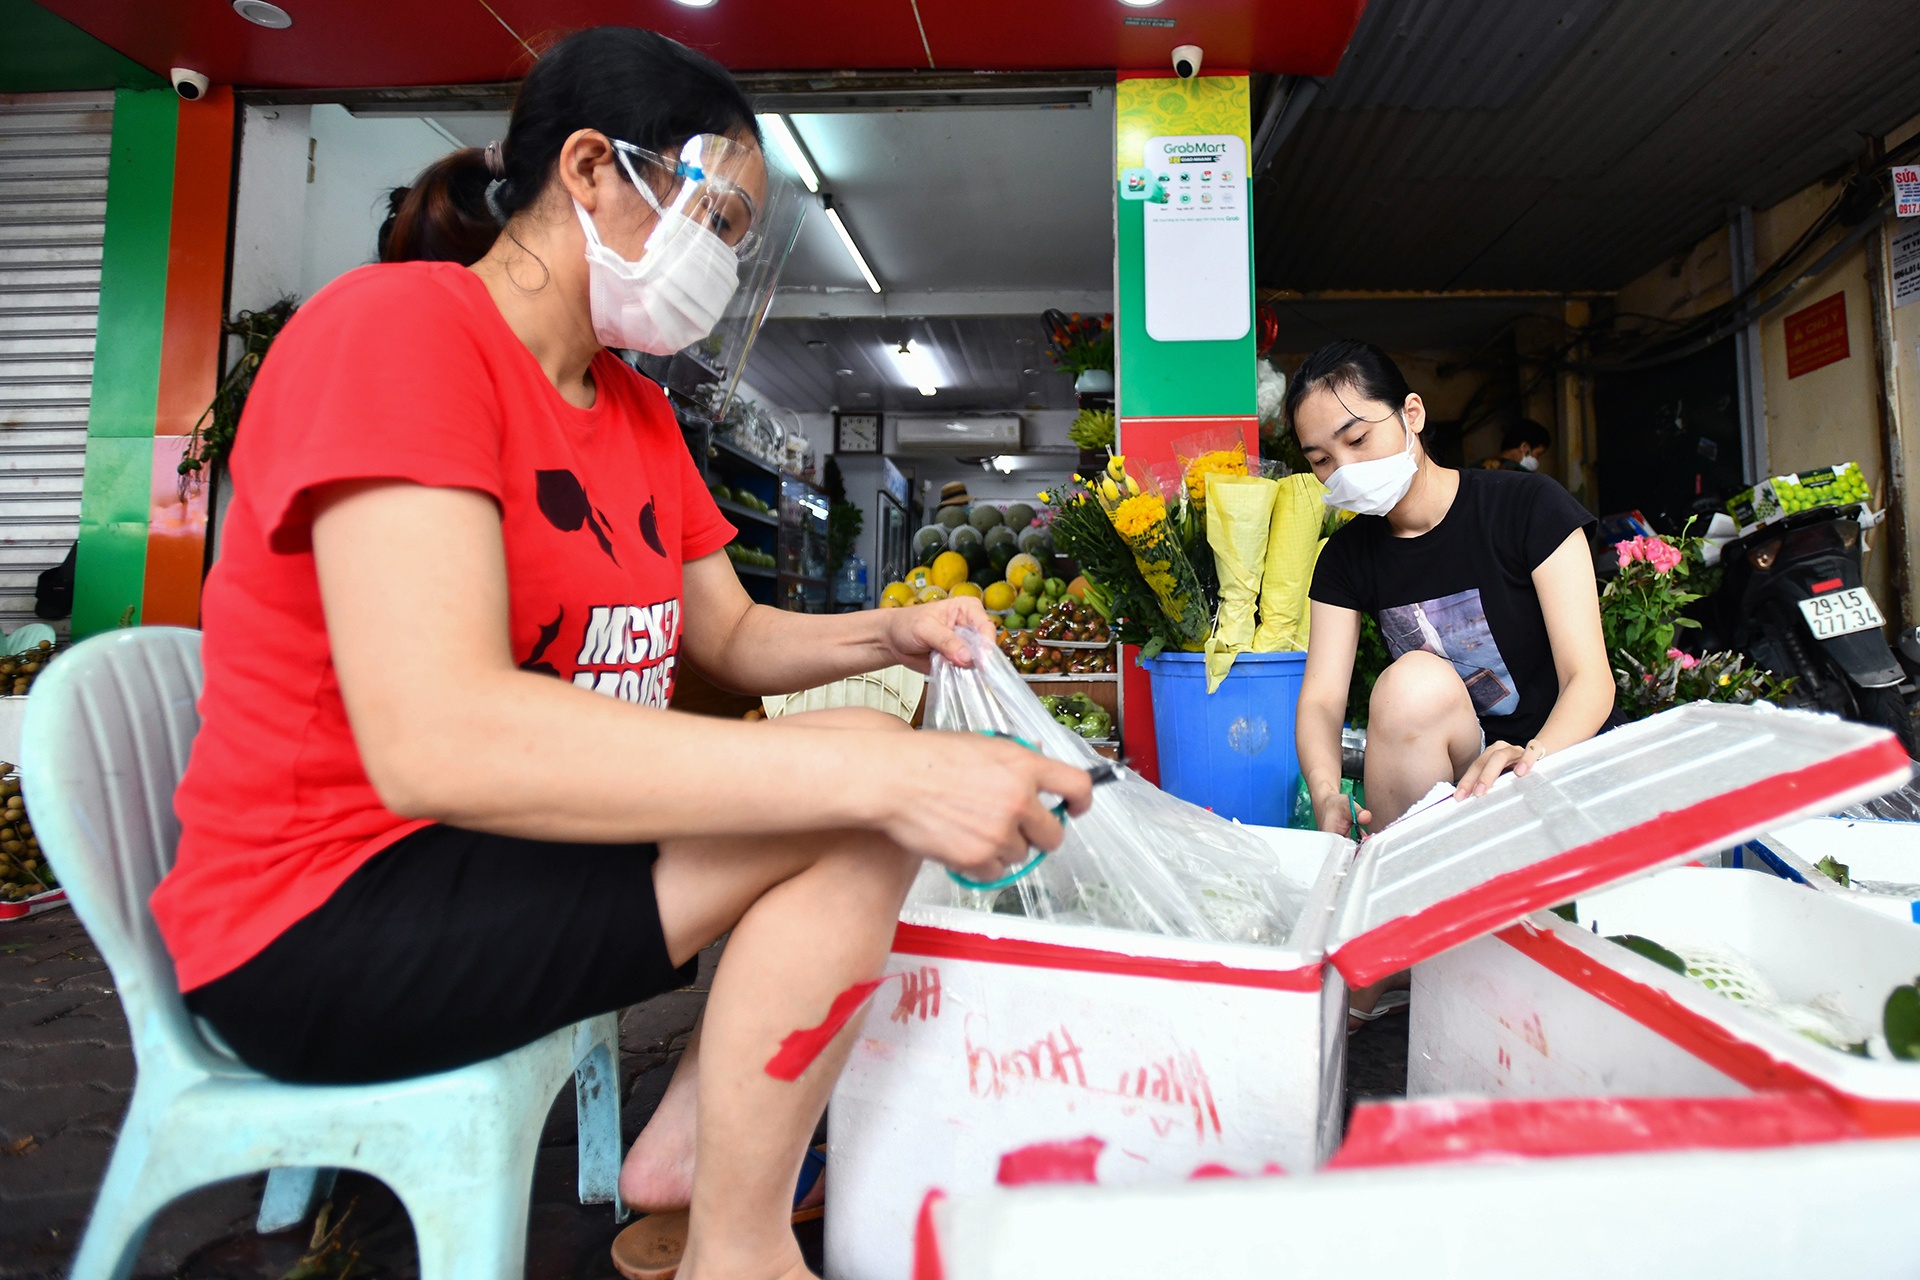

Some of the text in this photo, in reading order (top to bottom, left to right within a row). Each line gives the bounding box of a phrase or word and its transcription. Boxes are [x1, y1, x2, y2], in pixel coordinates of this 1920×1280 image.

[1163, 142, 1226, 154] GrabMart
[1894, 168, 1919, 184] SỬA
[1810, 591, 1862, 616] 29-L5
[1813, 608, 1878, 635] 277.34
